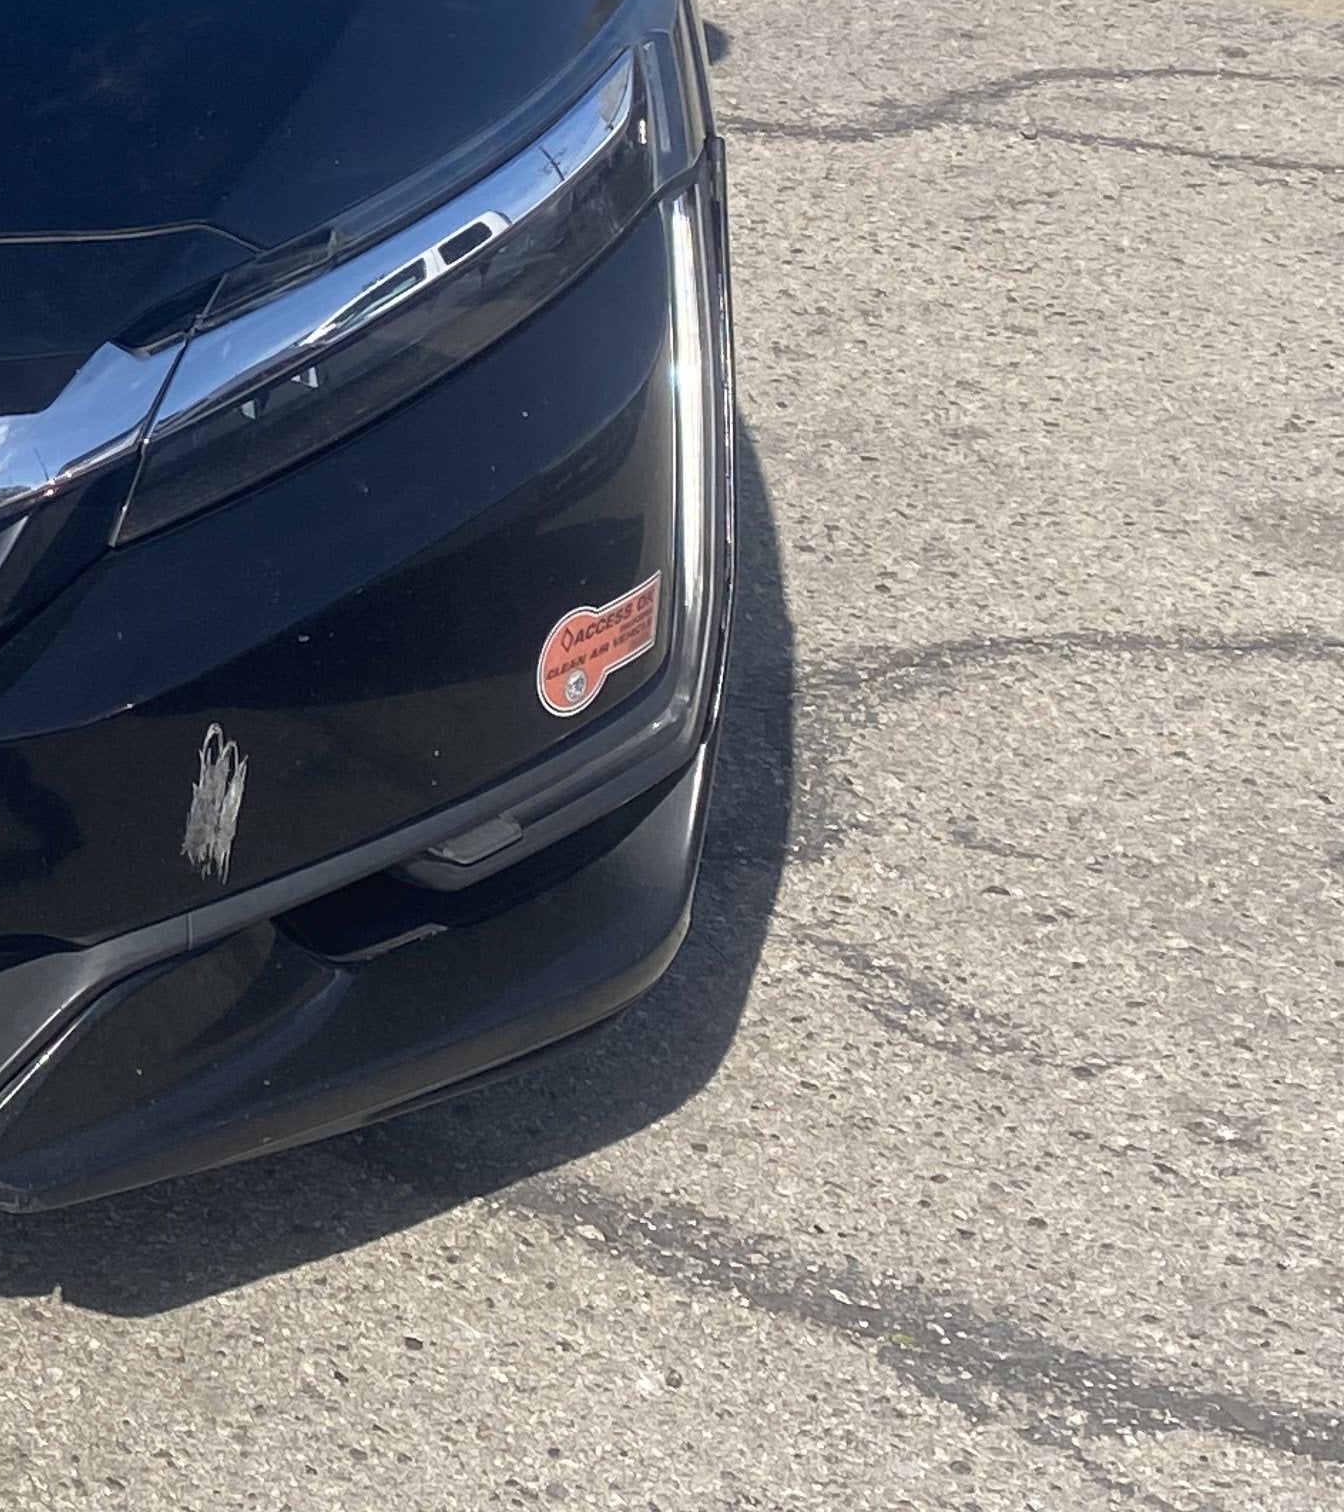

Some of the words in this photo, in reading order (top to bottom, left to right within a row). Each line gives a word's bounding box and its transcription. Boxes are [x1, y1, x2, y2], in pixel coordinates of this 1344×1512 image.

[573, 603, 633, 647] ACCESS
[545, 654, 587, 681] CLEAN
[589, 642, 610, 660] AIR
